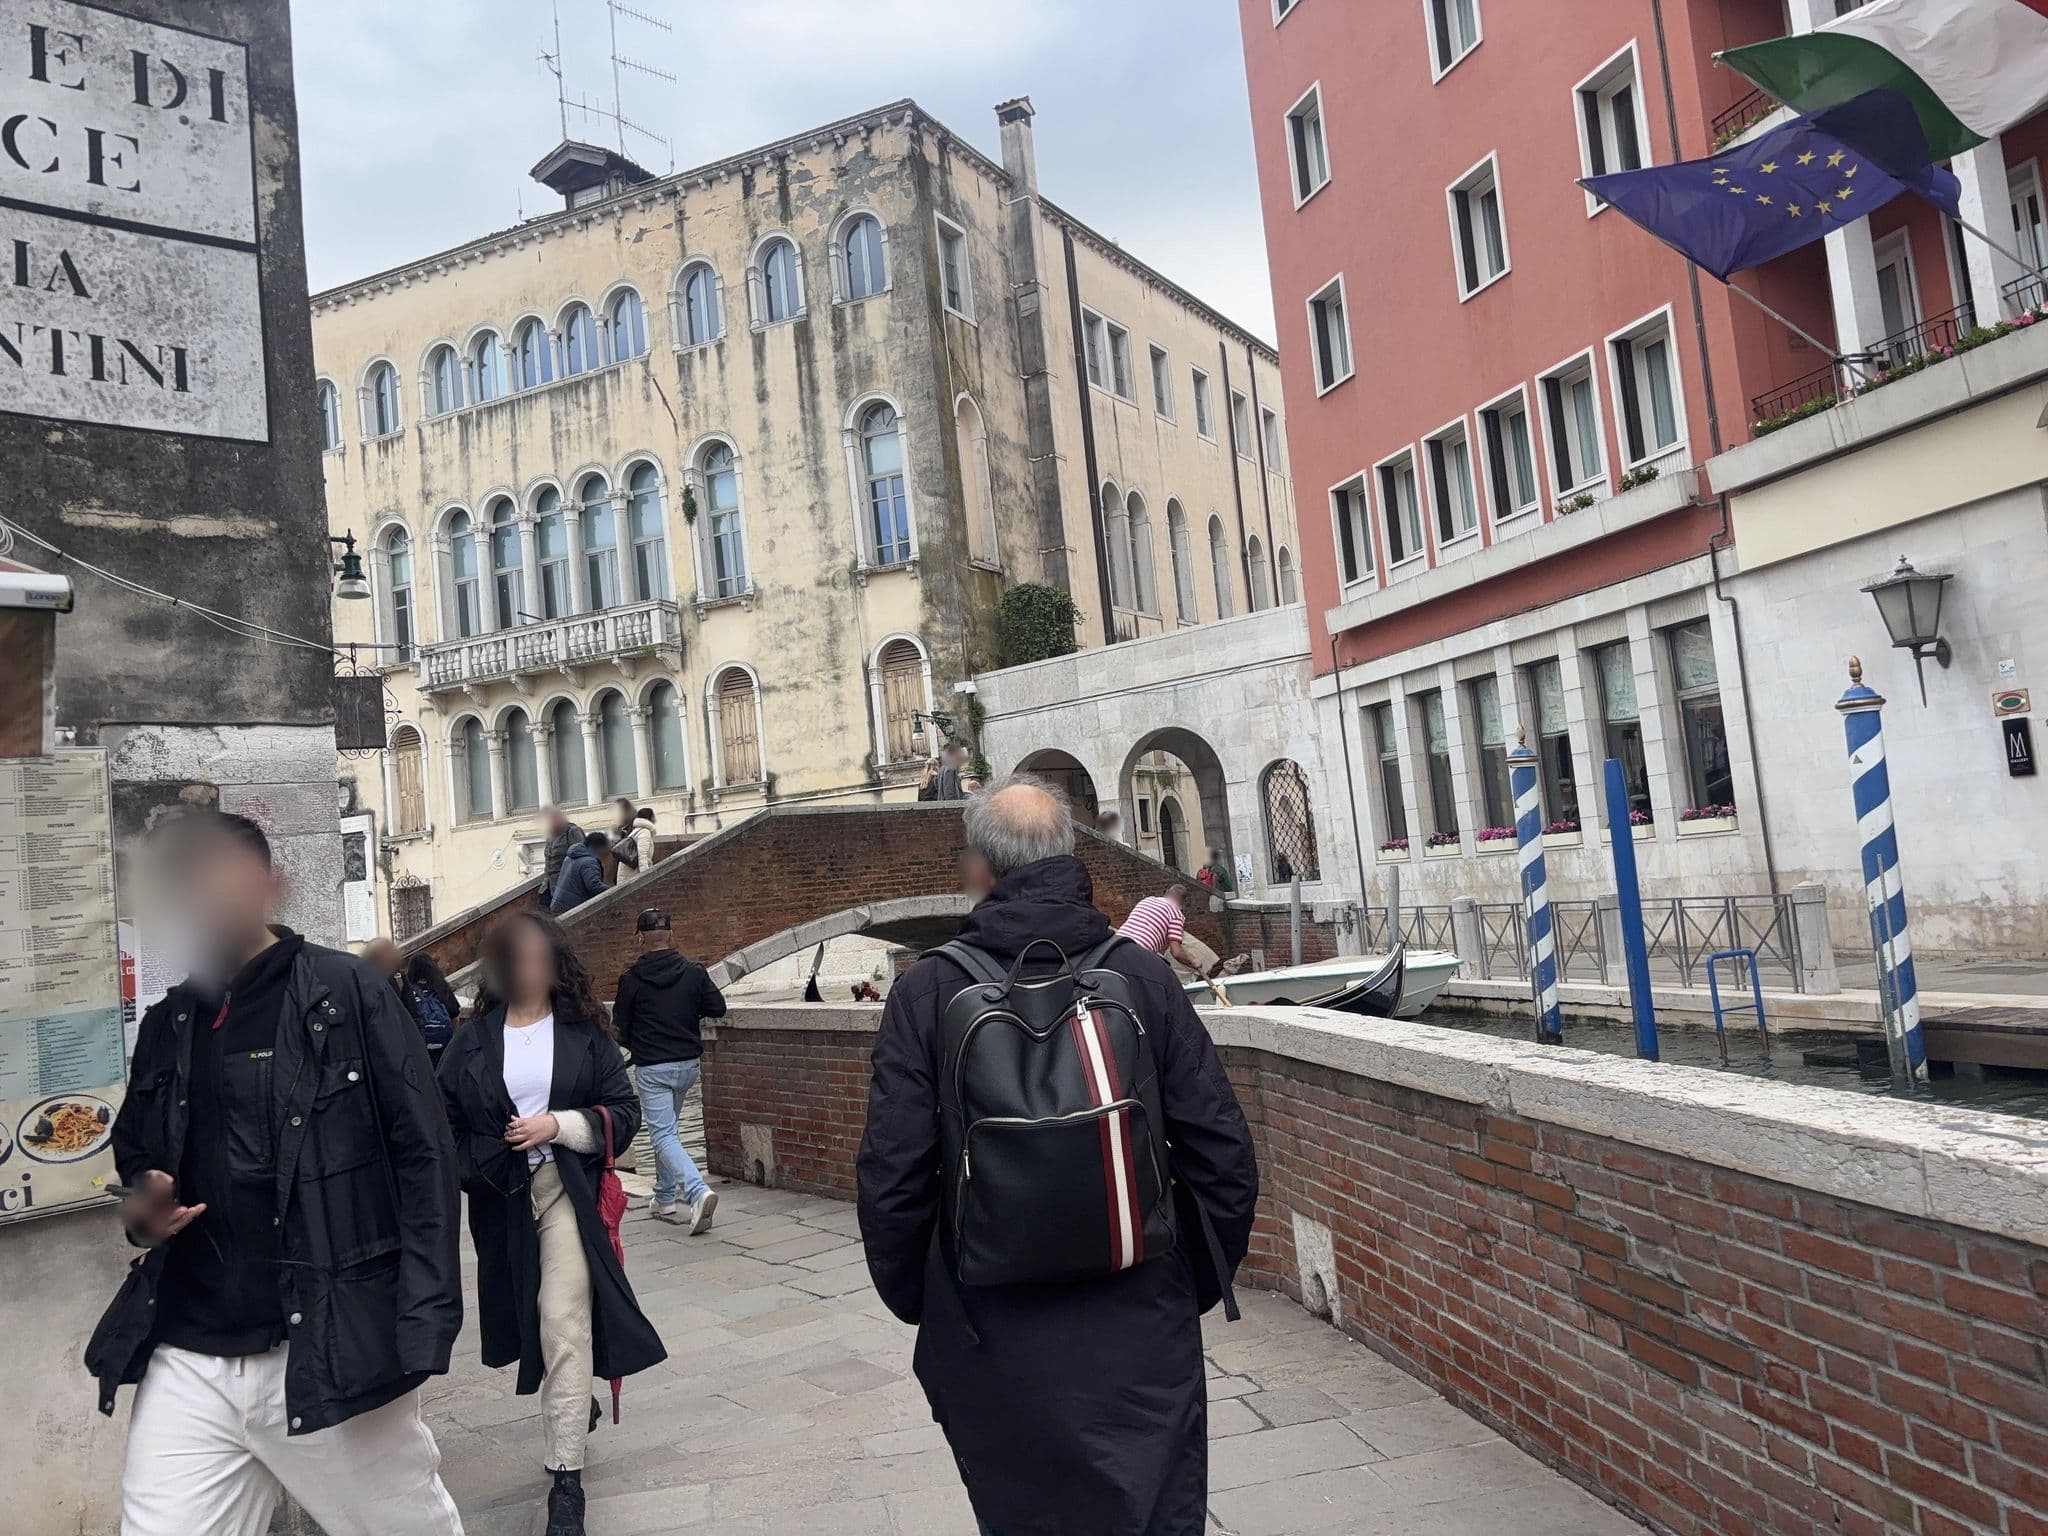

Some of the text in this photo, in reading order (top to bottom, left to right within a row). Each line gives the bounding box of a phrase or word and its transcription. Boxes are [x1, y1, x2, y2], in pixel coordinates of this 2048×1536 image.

[130, 49, 229, 124] DI
[1, 114, 141, 193] CE
[12, 239, 91, 299] IA
